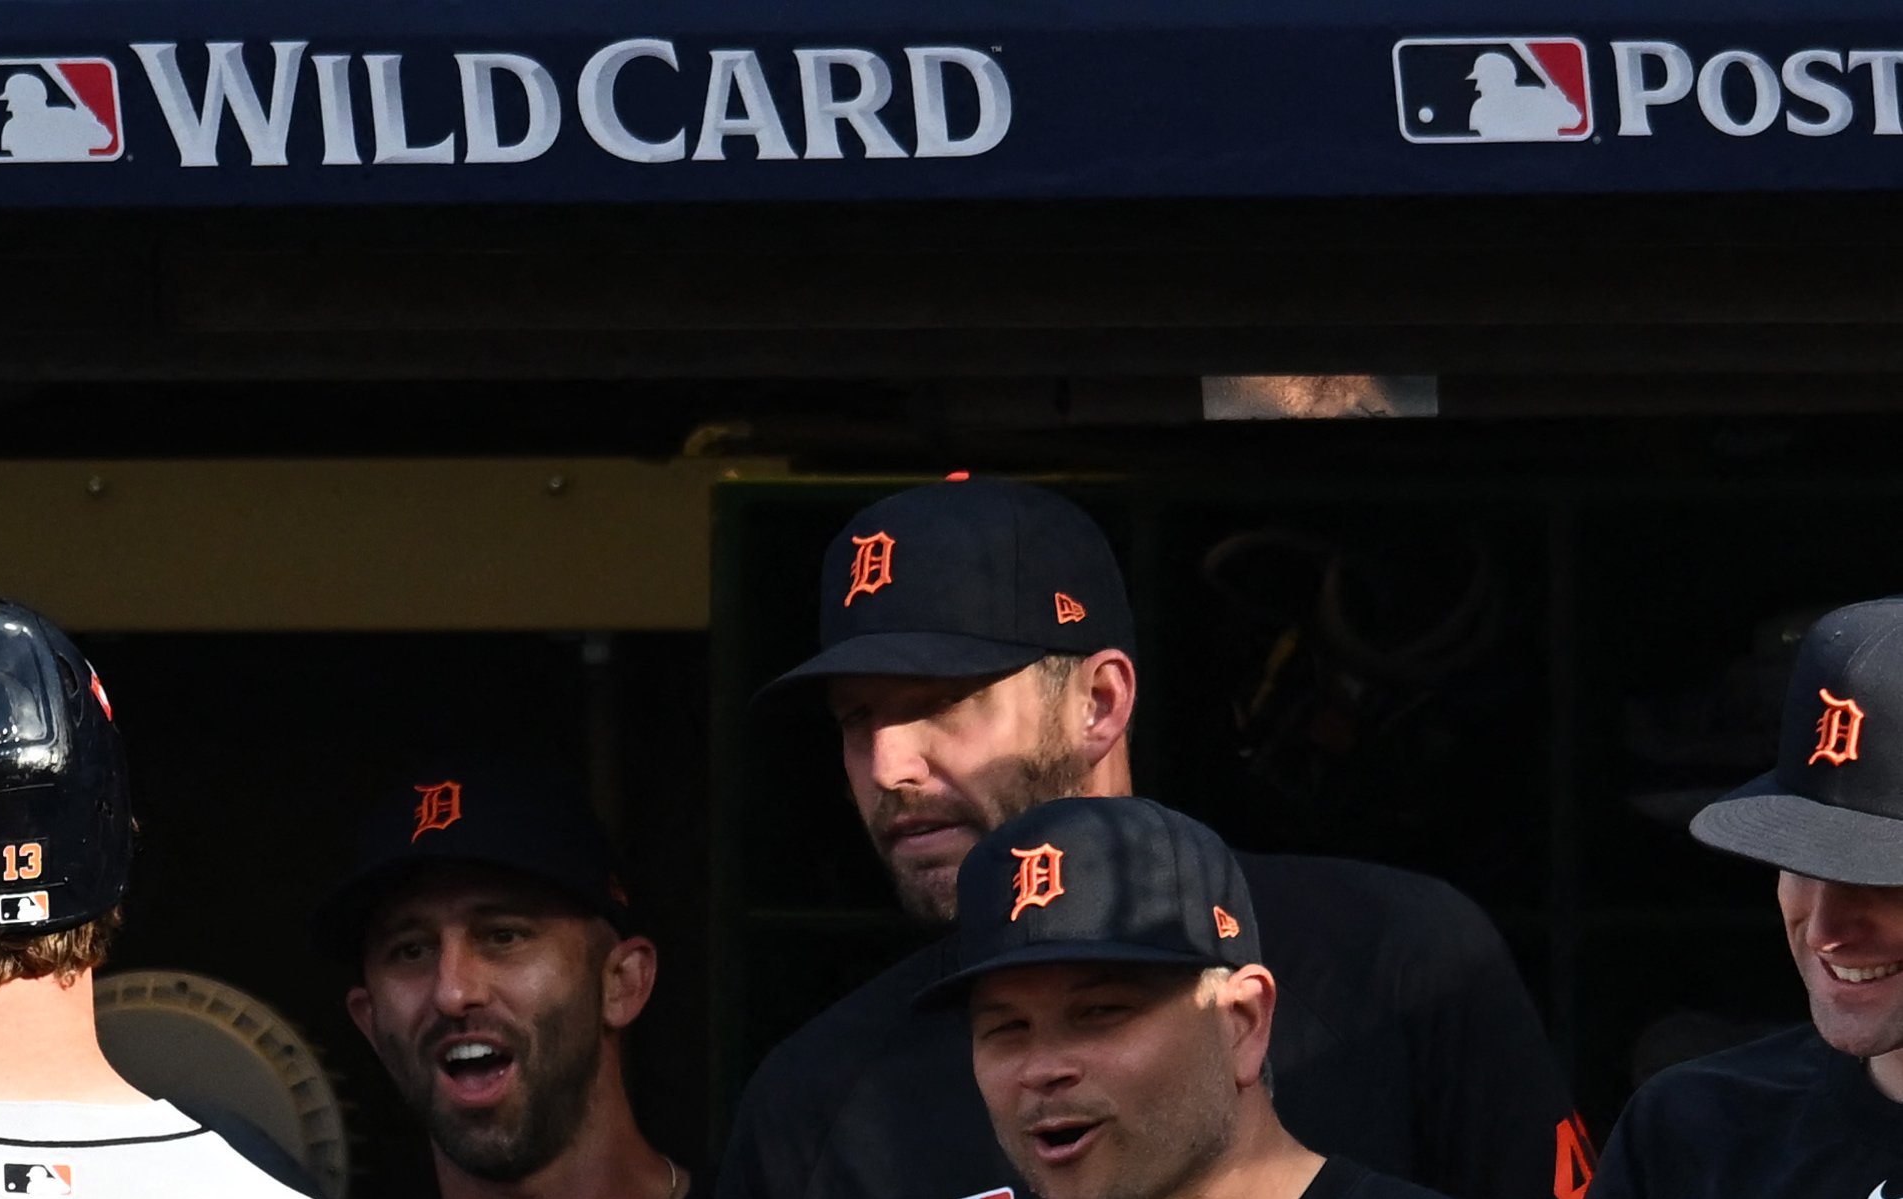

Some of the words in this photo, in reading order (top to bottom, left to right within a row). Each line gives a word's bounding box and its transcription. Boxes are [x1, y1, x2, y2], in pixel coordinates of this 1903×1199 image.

[1609, 40, 1903, 137] POST
[844, 531, 896, 607] D
[1808, 688, 1865, 766] D
[411, 780, 462, 843] D
[2, 843, 42, 881] 13
[1010, 842, 1064, 921] D
